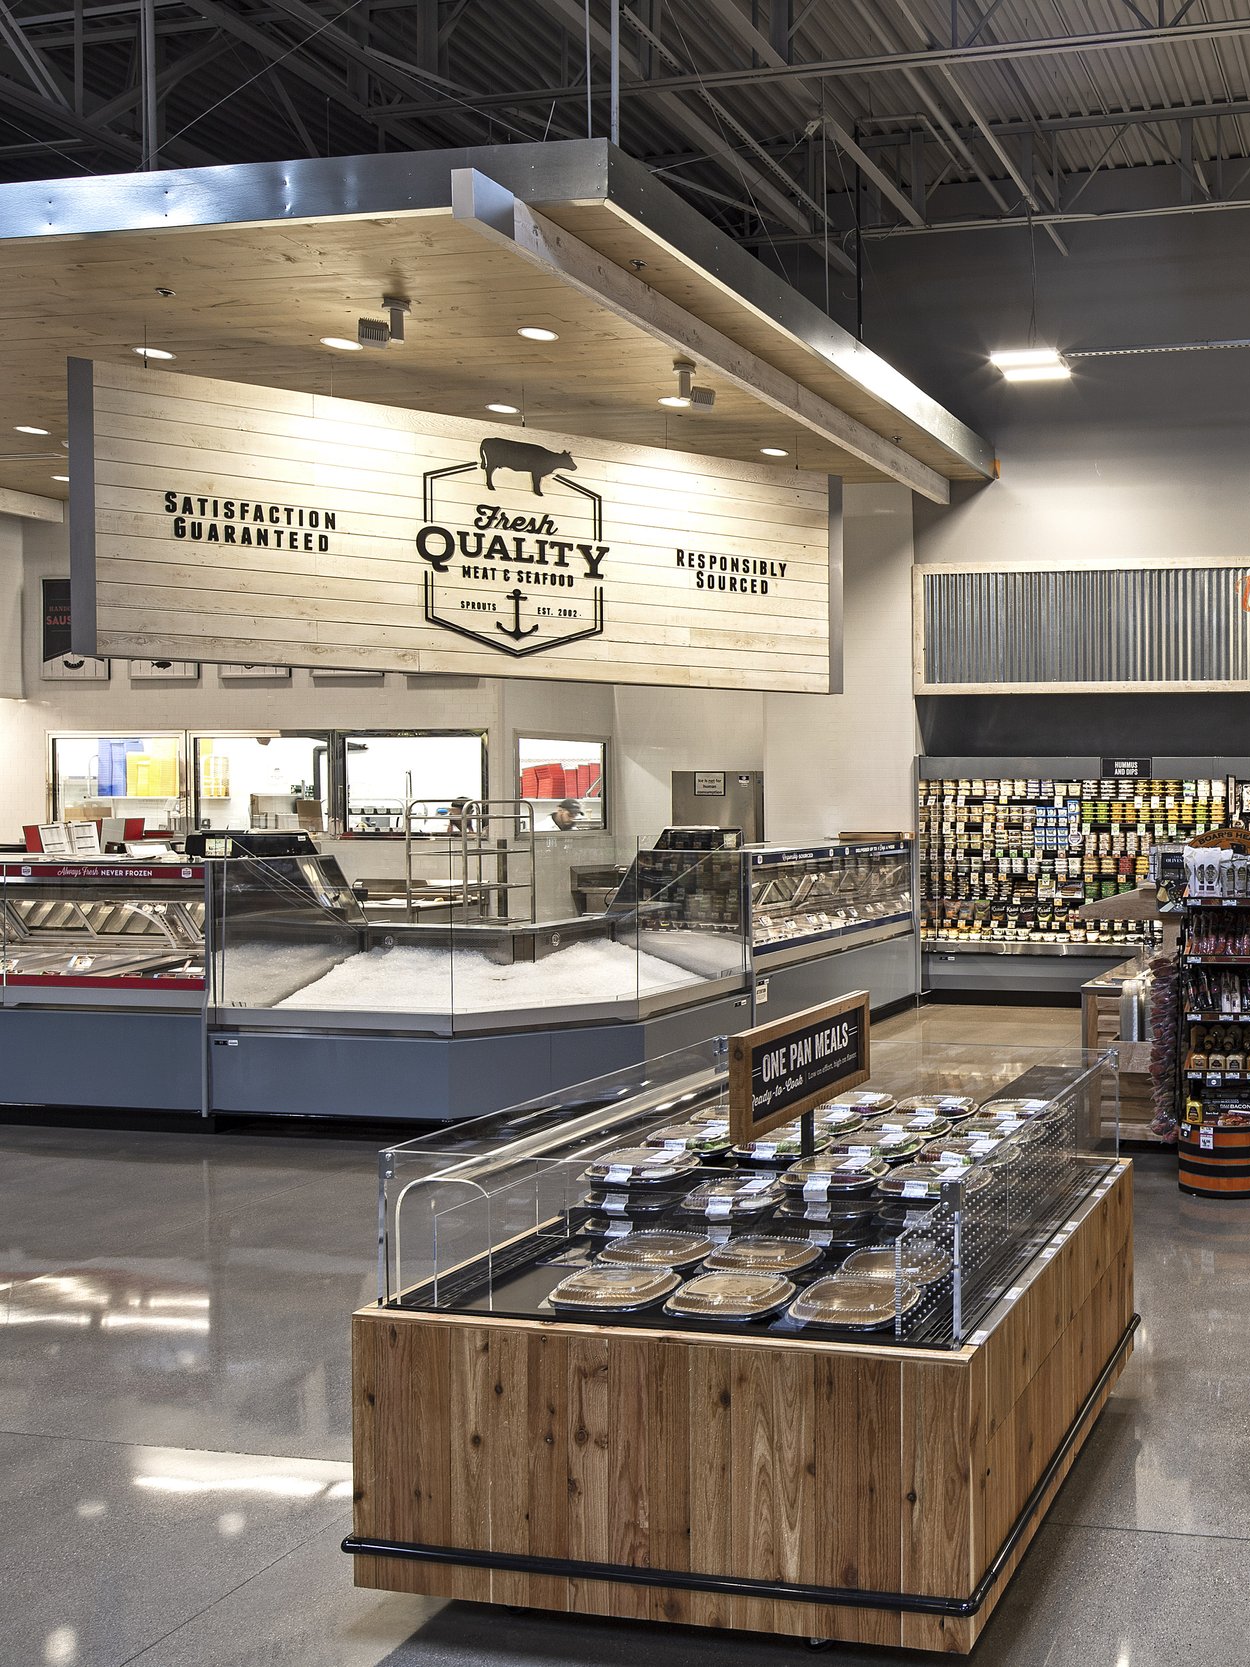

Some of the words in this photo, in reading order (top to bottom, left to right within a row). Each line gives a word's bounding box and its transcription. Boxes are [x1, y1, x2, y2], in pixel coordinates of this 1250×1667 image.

[165, 491, 336, 530] SATISFACTION
[474, 504, 558, 535] Fresh
[173, 517, 329, 552] GUARANTEED
[415, 526, 609, 580] QUALITY
[676, 549, 787, 577] RESPONSIBLY
[462, 565, 496, 580] MEAT
[503, 569, 510, 582] &
[517, 570, 574, 587] SEAFOOD
[696, 570, 768, 594] SOURCED
[46, 616, 72, 625] SAUS
[460, 601, 497, 611] SPROUTS
[537, 607, 553, 616] EST.
[1114, 761, 1138, 769] HUMMUS
[1198, 831, 1233, 845] BOAR'S
[57, 867, 81, 878] Always
[82, 867, 99, 876] Fresh
[762, 1047, 787, 1082] ONE
[790, 1037, 812, 1071] PAN
[814, 1022, 849, 1060] MEALS
